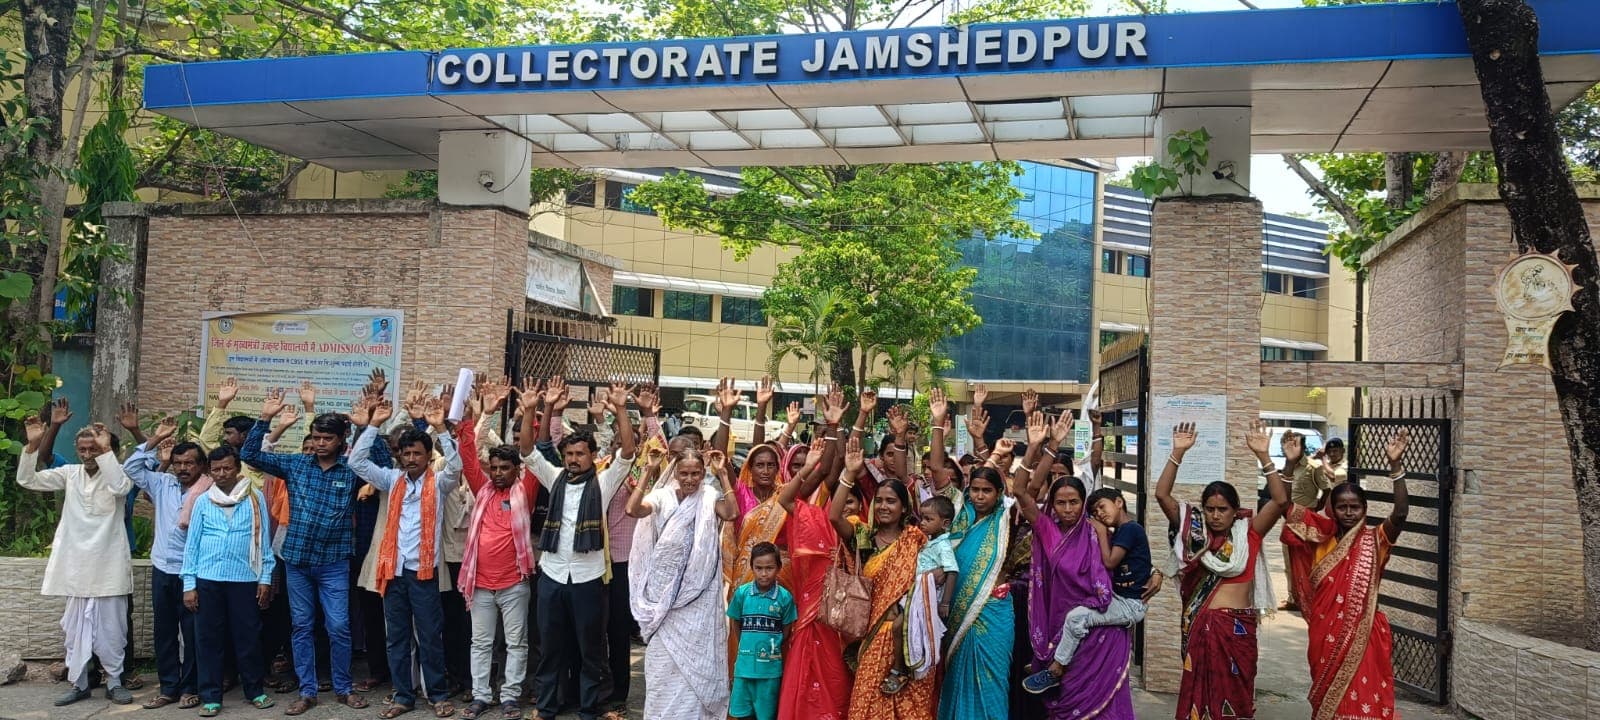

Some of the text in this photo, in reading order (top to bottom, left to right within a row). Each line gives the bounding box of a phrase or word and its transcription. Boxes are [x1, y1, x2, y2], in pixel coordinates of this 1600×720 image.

[437, 22, 1148, 85] COLLECTORATE JAMSHEDPUR
[319, 344, 367, 354] ADMISSION
